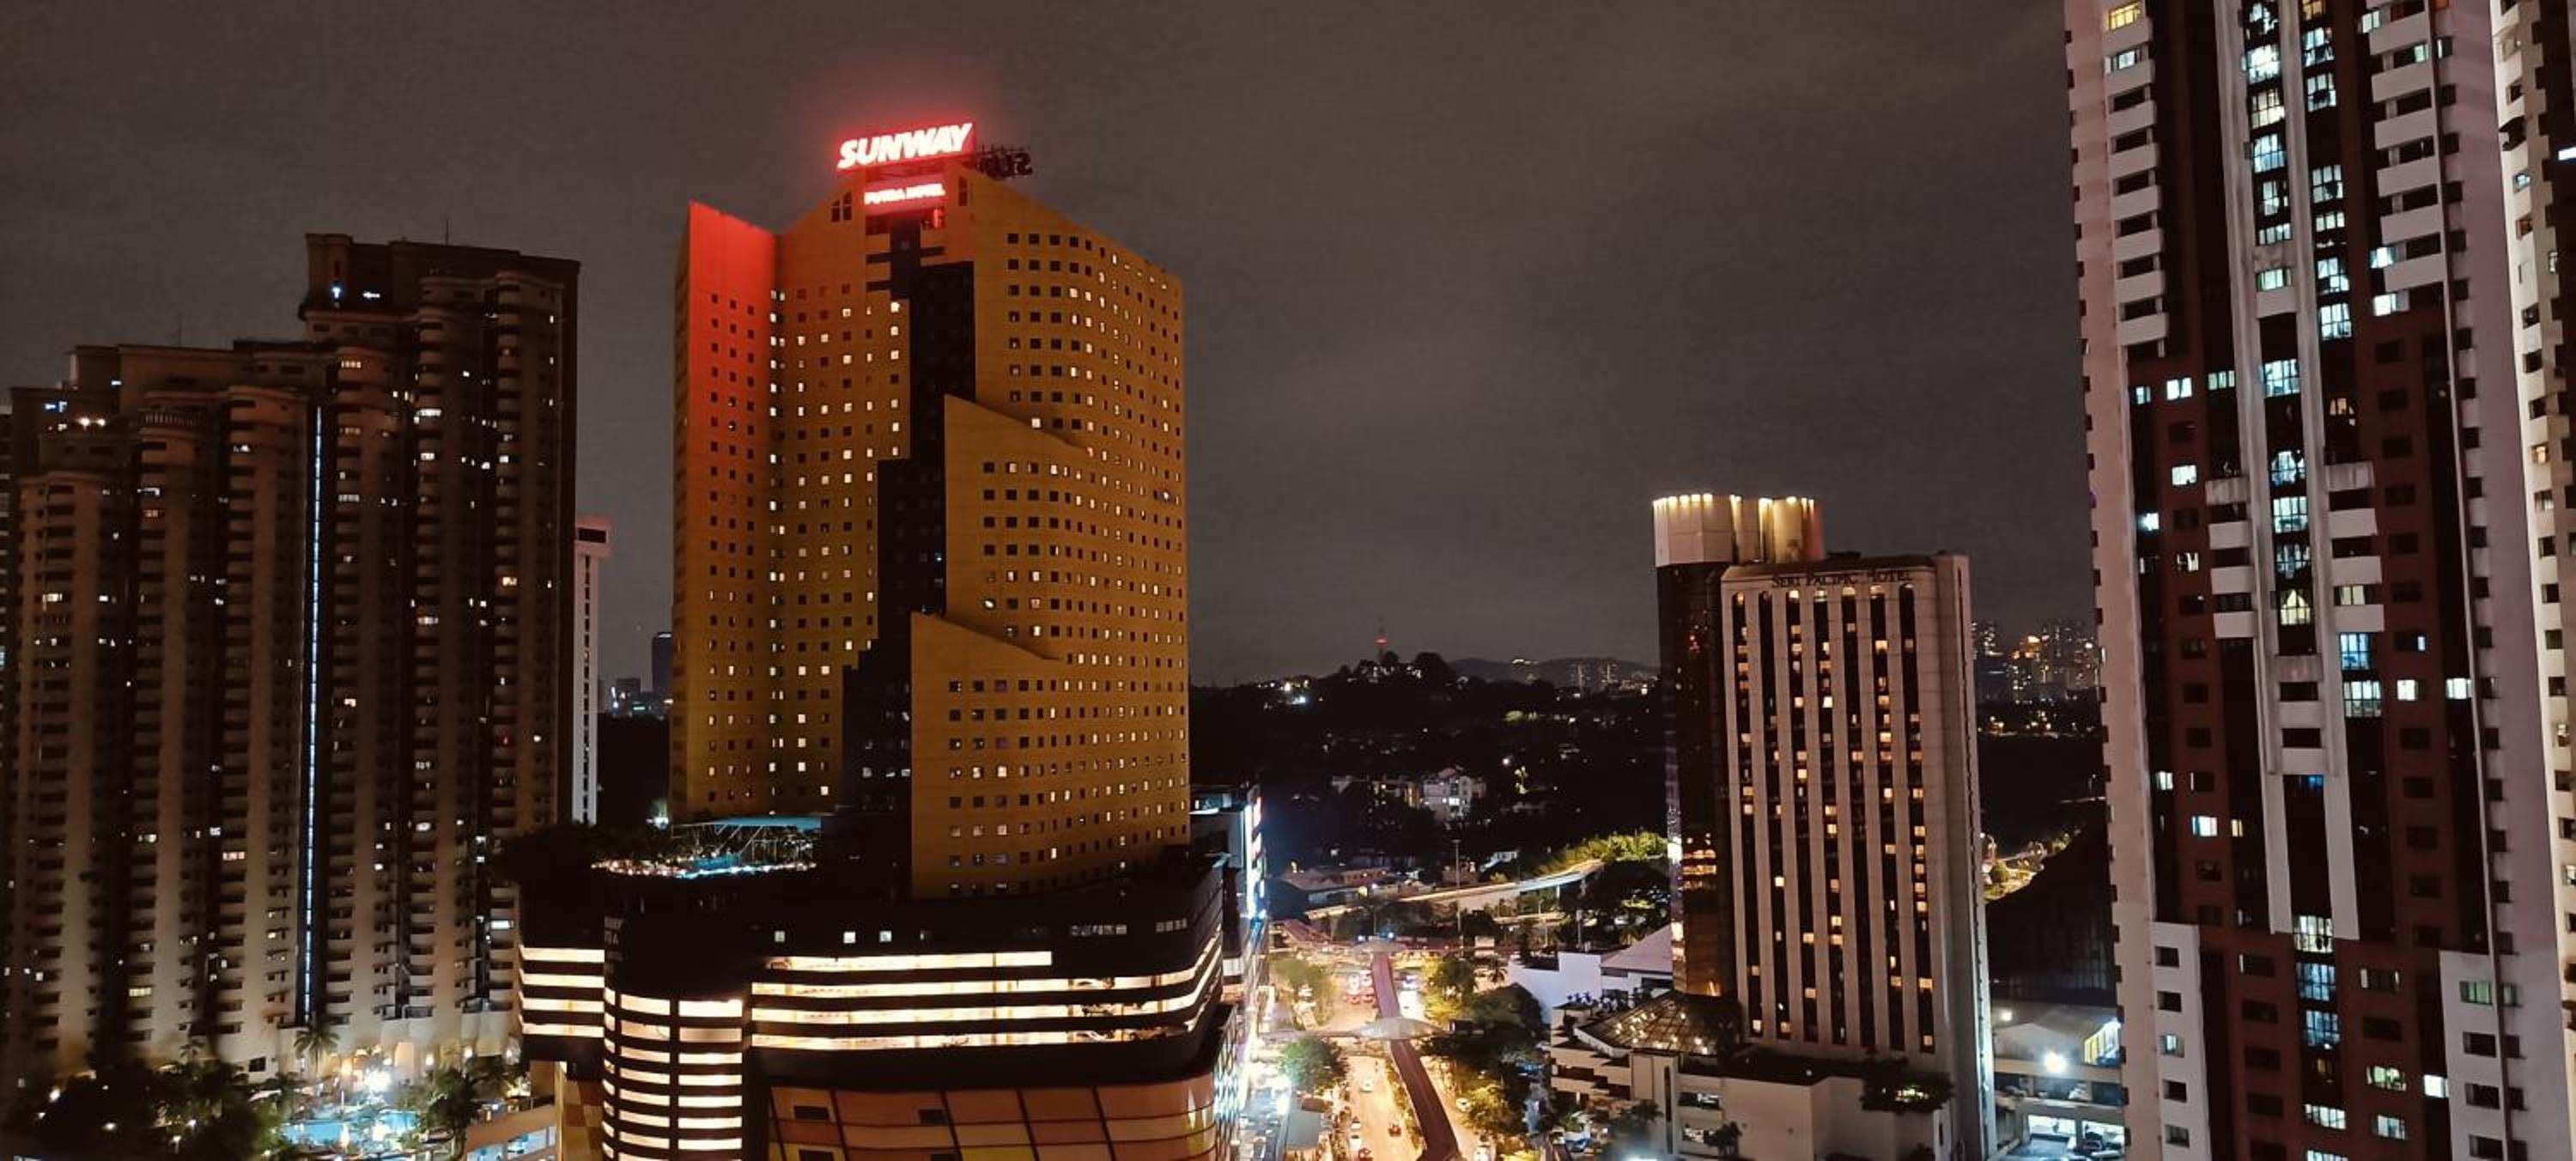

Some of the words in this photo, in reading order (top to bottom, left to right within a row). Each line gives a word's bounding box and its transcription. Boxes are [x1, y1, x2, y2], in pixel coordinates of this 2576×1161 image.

[837, 123, 973, 169] SUNWAY
[864, 187, 905, 205] PUTRA
[906, 183, 945, 199] HOTEL
